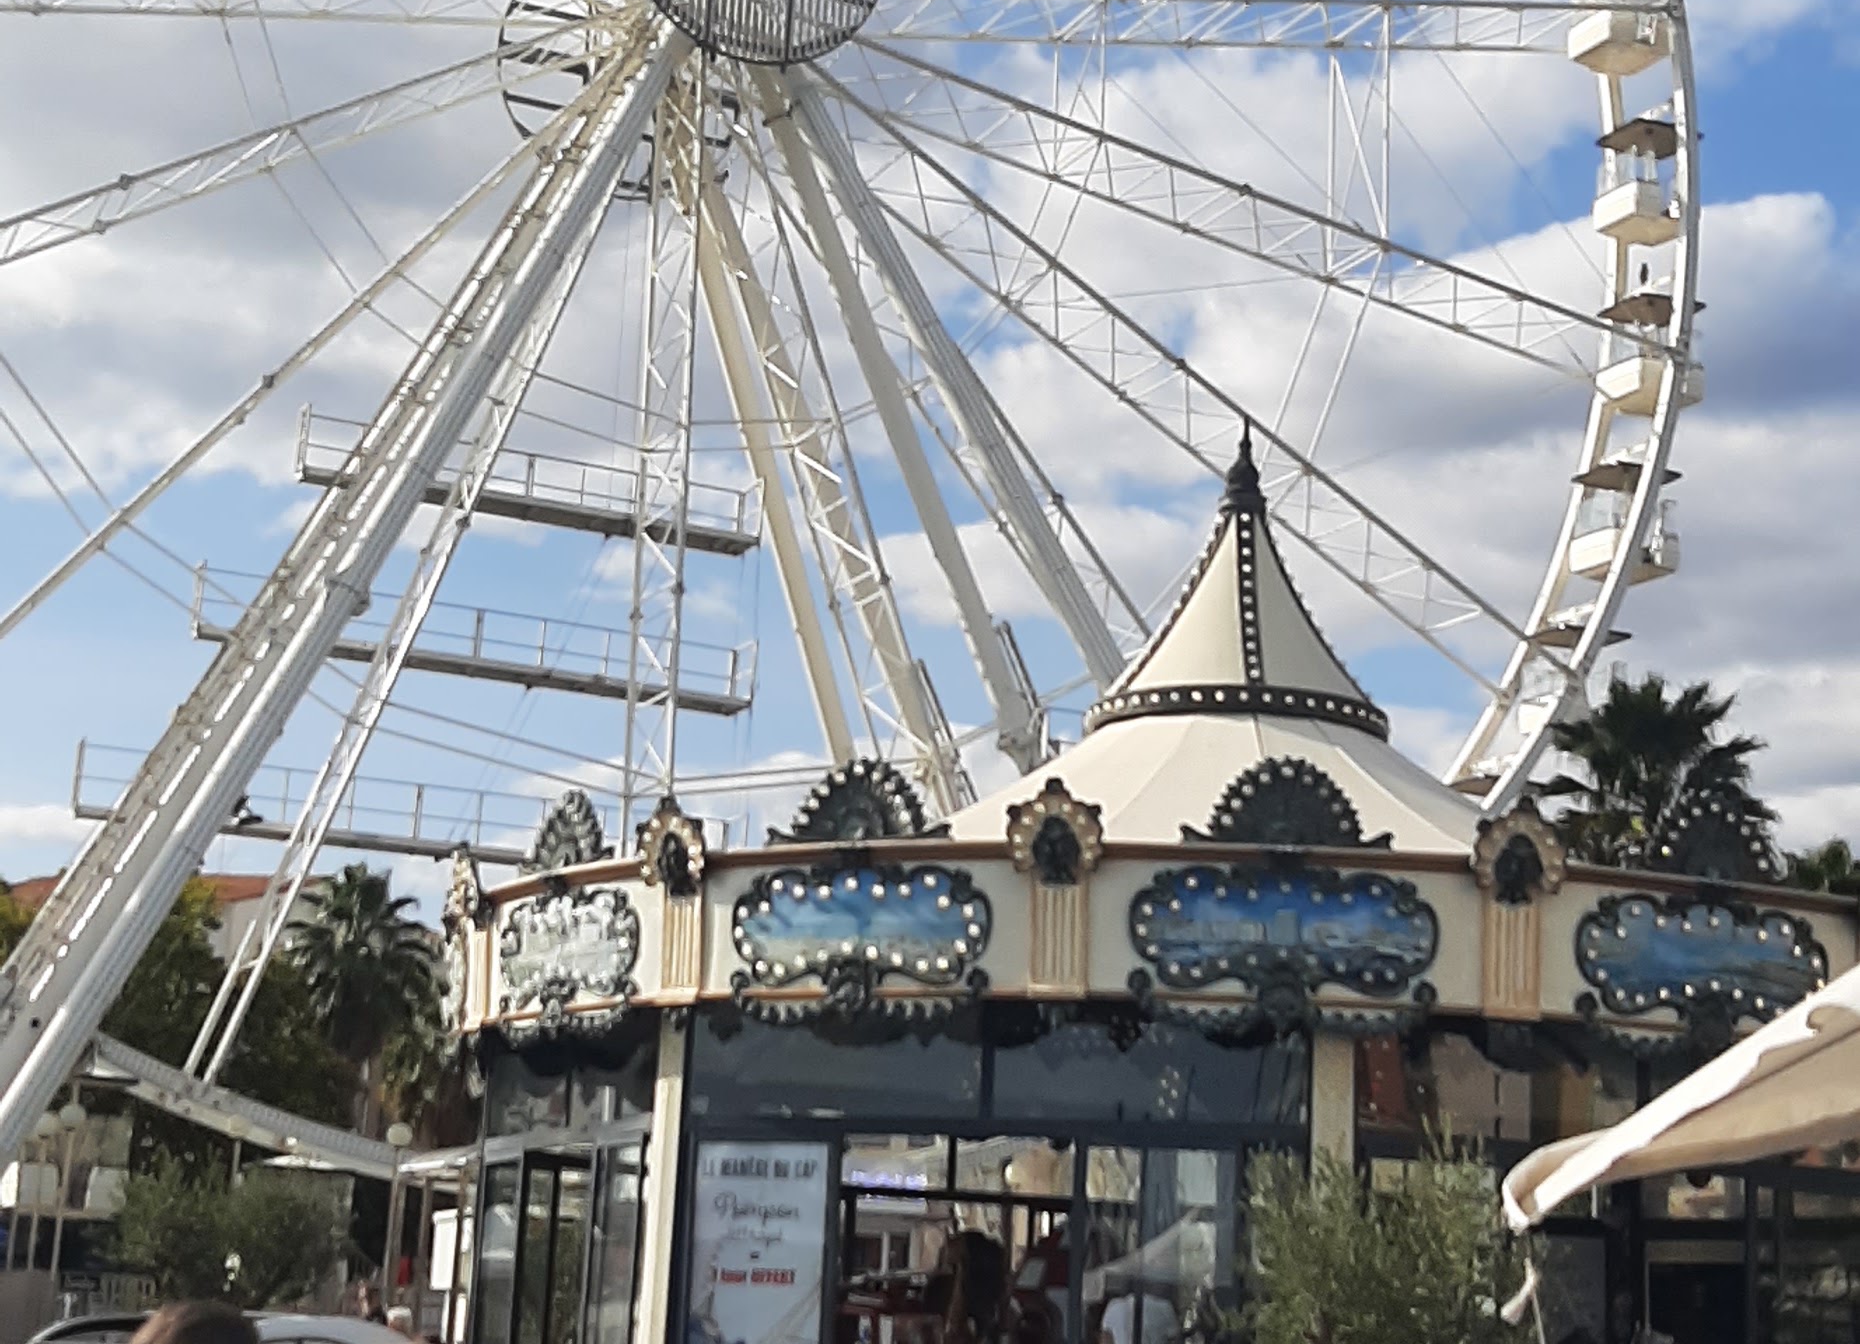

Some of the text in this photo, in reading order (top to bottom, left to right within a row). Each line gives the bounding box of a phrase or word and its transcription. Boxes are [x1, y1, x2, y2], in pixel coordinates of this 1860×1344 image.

[701, 1159, 714, 1176] LE
[774, 1159, 789, 1178] DU
[795, 1159, 817, 1178] CAP
[751, 1268, 796, 1284] OFFERT
